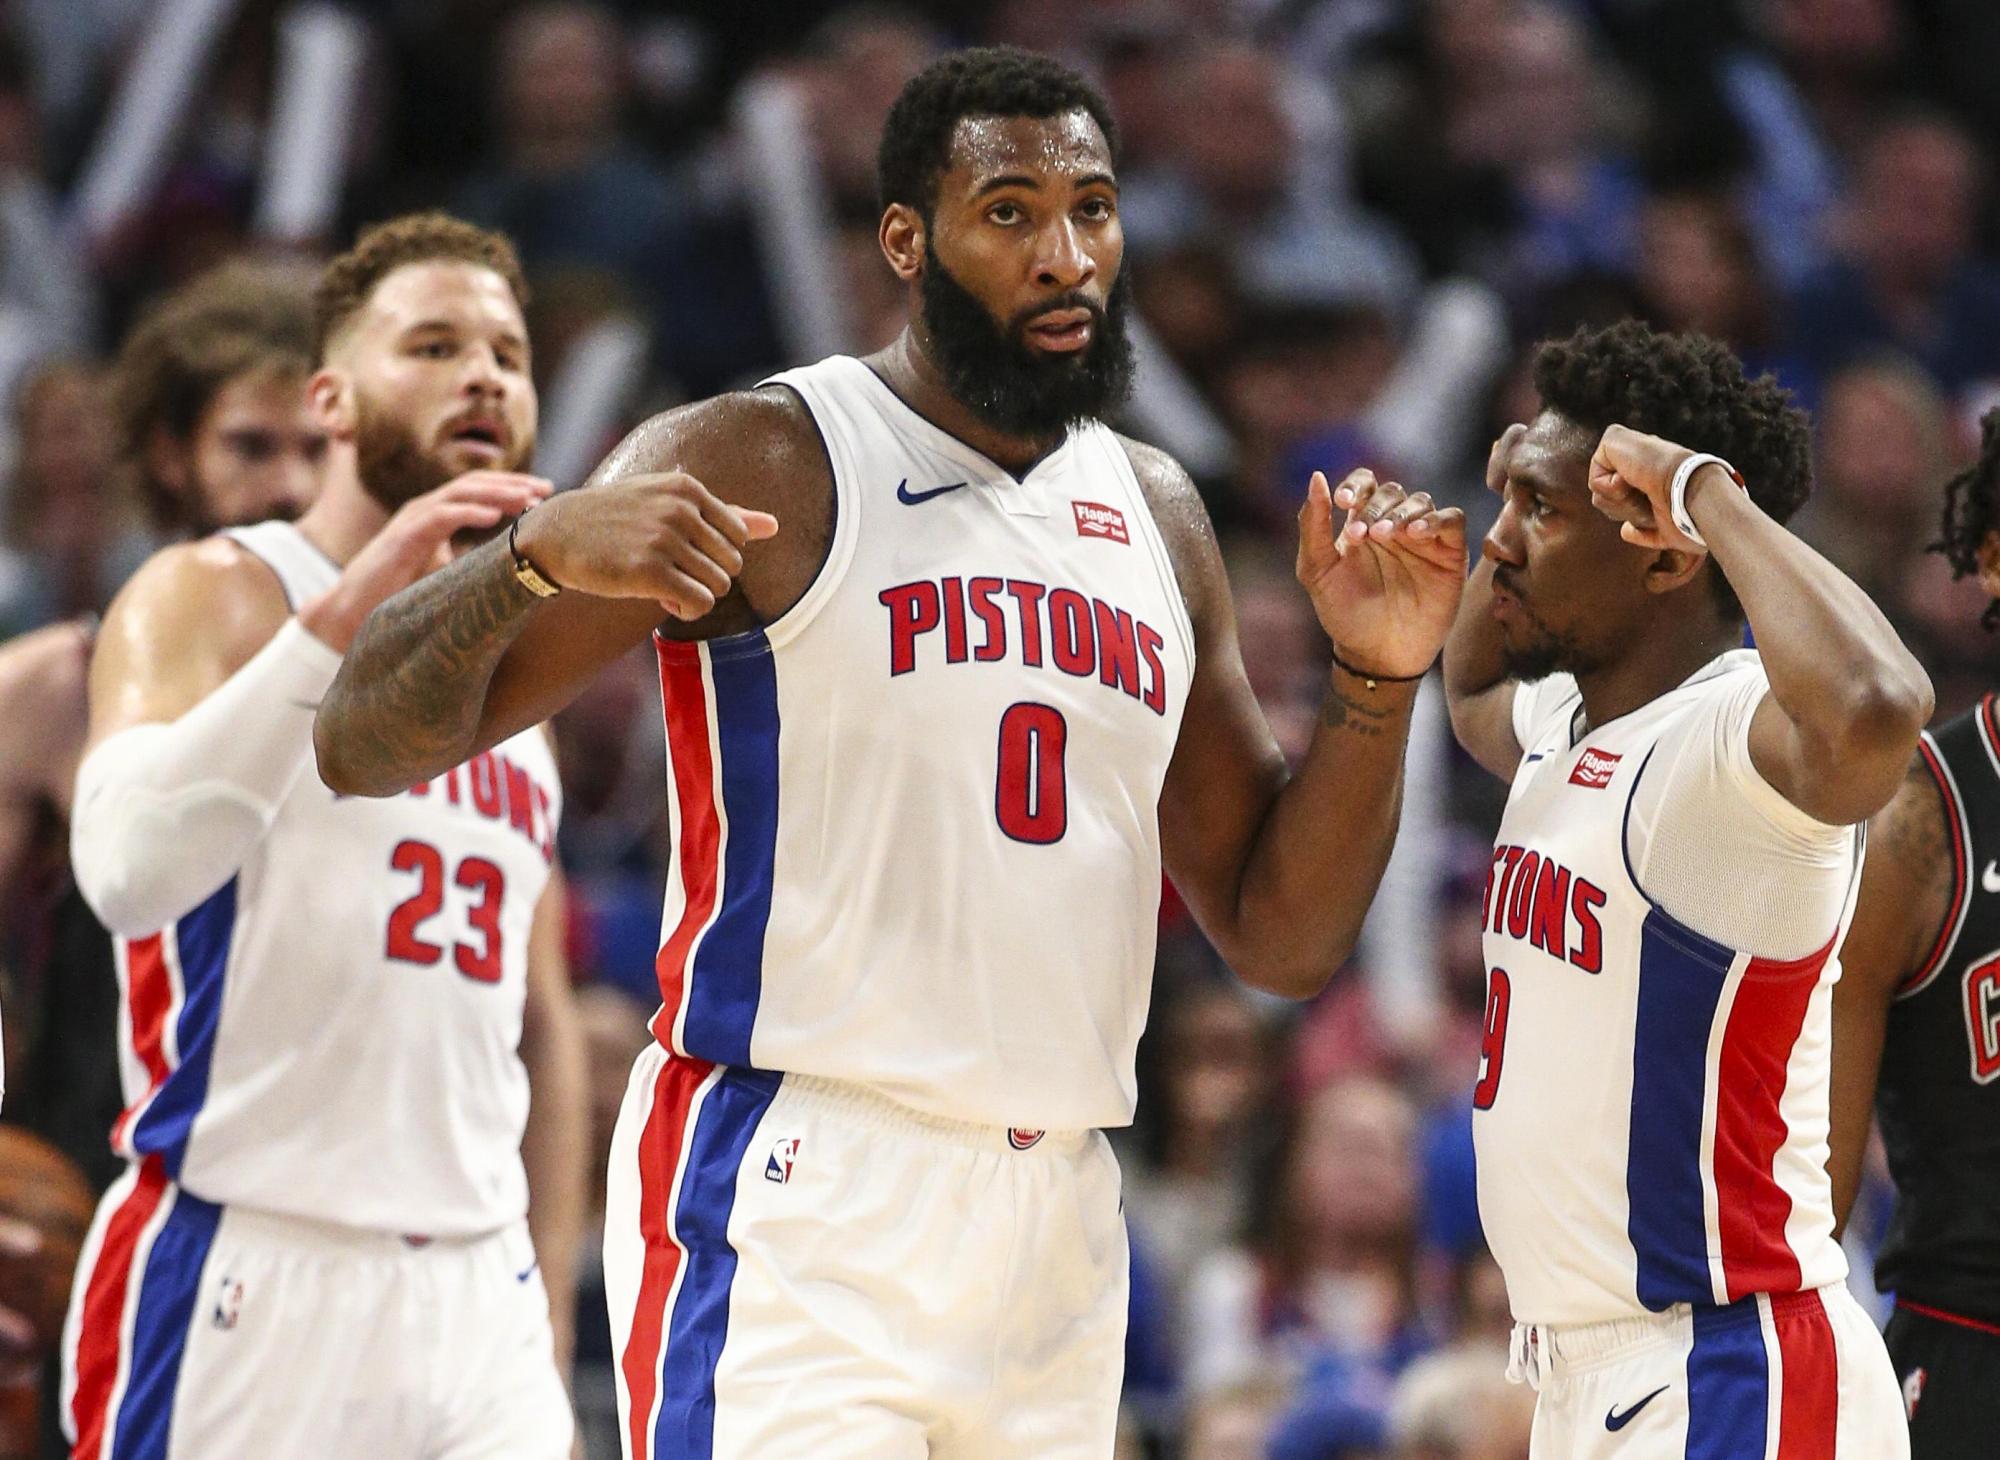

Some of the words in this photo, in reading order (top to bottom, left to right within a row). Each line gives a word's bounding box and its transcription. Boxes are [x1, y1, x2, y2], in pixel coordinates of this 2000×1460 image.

[1076, 504, 1123, 528] Flagstar
[878, 575, 1166, 717] PISTONS
[995, 701, 1067, 845] 0
[386, 838, 506, 986] 23
[1473, 967, 1511, 1110] 9
